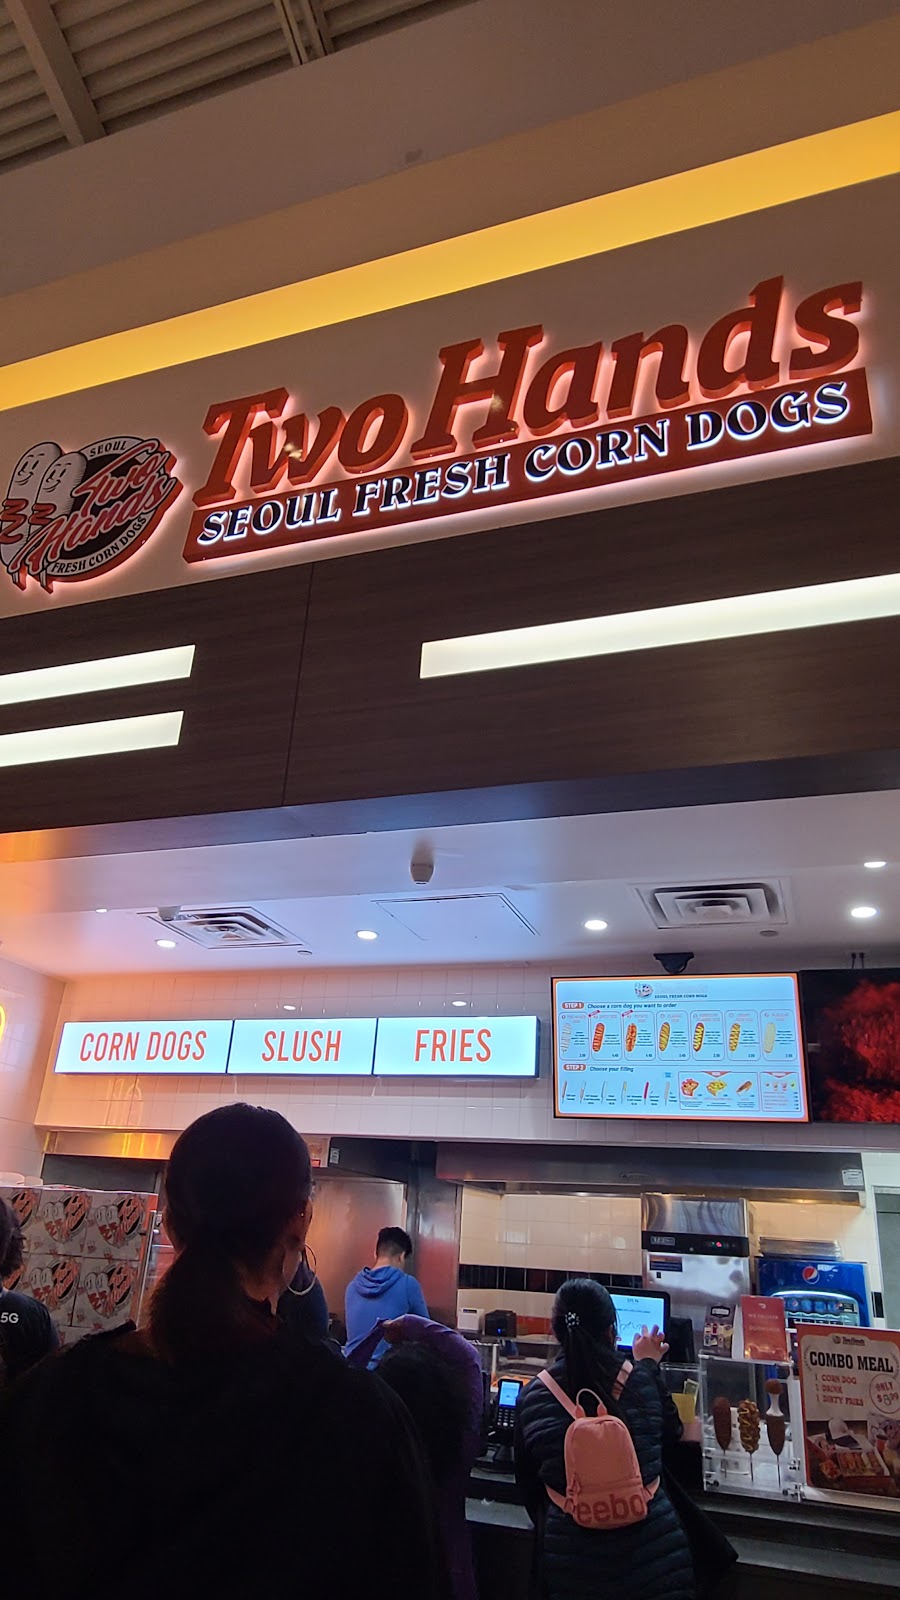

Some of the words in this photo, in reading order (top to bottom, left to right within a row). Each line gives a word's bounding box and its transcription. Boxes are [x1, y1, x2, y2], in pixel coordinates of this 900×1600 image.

[192, 387, 409, 506] Two
[410, 275, 863, 459] Hands
[89, 440, 127, 457] SEOUL
[197, 488, 342, 545] SEOUL
[352, 453, 511, 517] FRESH
[524, 418, 670, 481] CORN
[687, 381, 850, 451] DOGS
[72, 439, 169, 518] Two
[8, 475, 177, 573] Hands
[51, 559, 86, 574] FRESH
[88, 543, 120, 567] CORN
[121, 516, 147, 547] DOGS
[80, 1032, 140, 1062] CORN
[146, 1031, 207, 1061] DOGS
[262, 1030, 341, 1062] SLUSH
[414, 1029, 492, 1062] FRIES
[0, 1312, 19, 1324] 5G
[810, 1351, 853, 1369] COMBO
[857, 1355, 893, 1373] MEAL
[821, 1374, 840, 1383] CORN
[842, 1376, 857, 1384] DOG
[822, 1384, 843, 1393] DRINK
[876, 1382, 893, 1391] ONLY
[822, 1395, 844, 1404] DIRTY
[845, 1398, 864, 1406] FRIES
